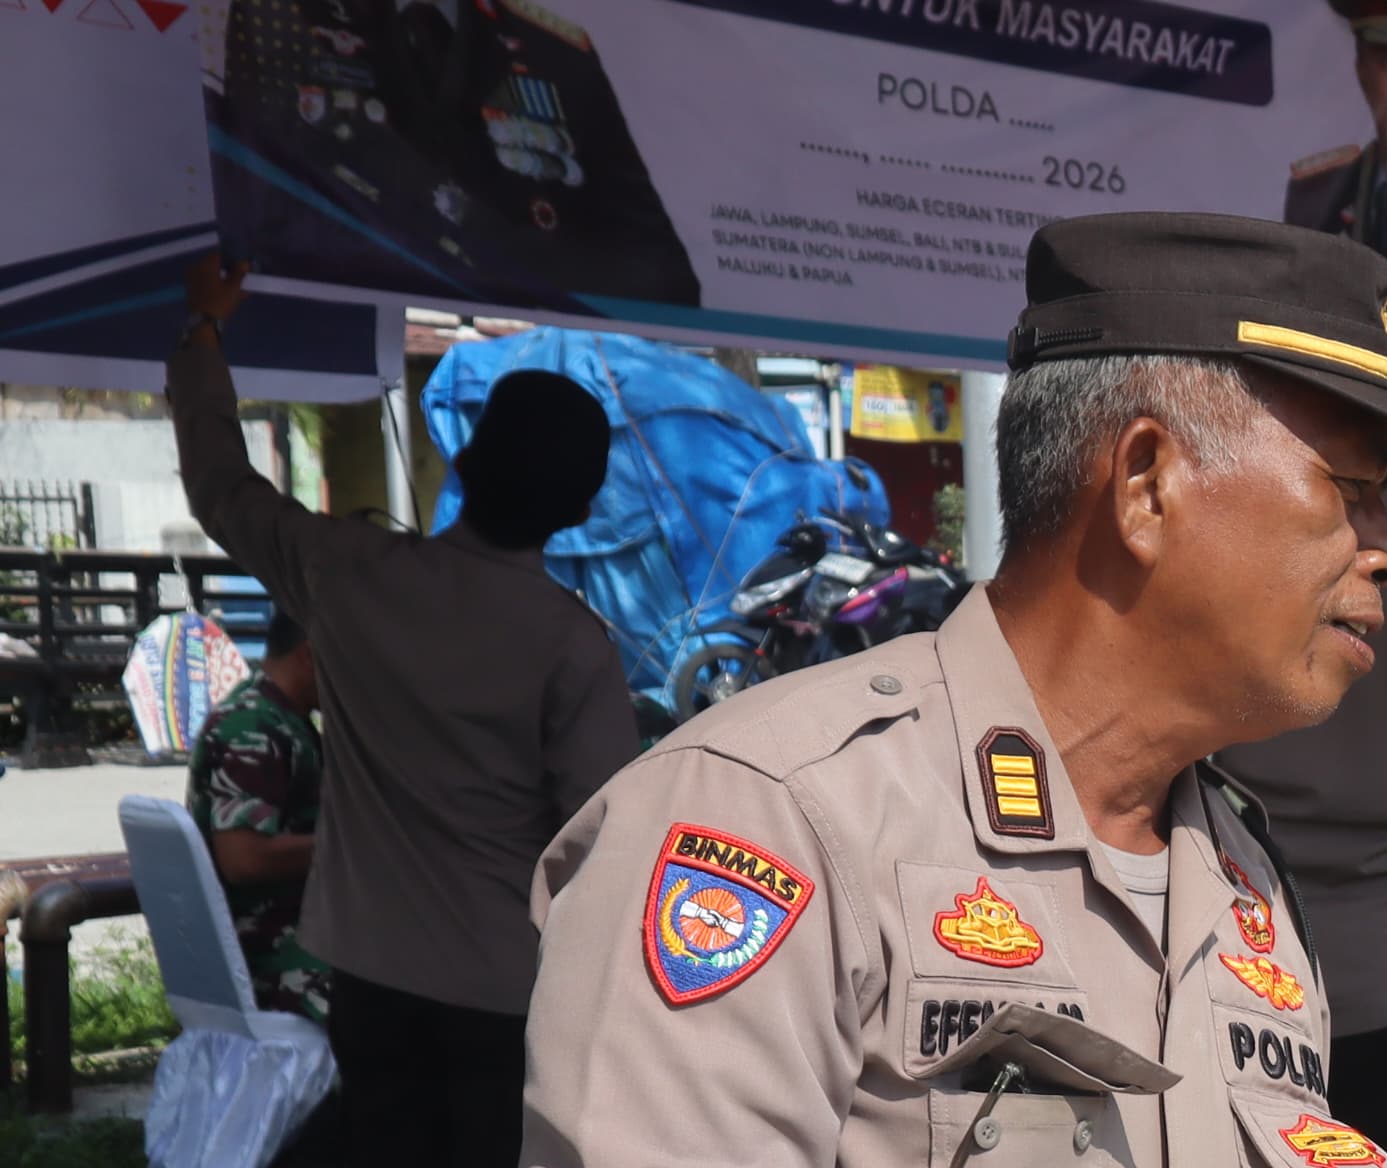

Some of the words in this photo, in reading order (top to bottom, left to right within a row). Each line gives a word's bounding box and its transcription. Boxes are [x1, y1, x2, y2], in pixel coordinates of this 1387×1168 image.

[996, 0, 1235, 76] MASYARAKAT
[877, 72, 1000, 122] POLDA
[1042, 156, 1126, 194] 2026
[710, 203, 754, 226] JAWA,
[760, 210, 843, 238] LAMPUNG,
[856, 189, 919, 213] HARGA
[923, 200, 992, 224] ECERAN
[712, 230, 798, 255] SUMATERA
[803, 243, 844, 260] (NON
[848, 246, 923, 270] LAMPUNG
[717, 256, 786, 280] MALUKU
[802, 267, 853, 287] PAPUA
[676, 835, 799, 902] BINMAS
[1229, 1022, 1327, 1098] POLRI
